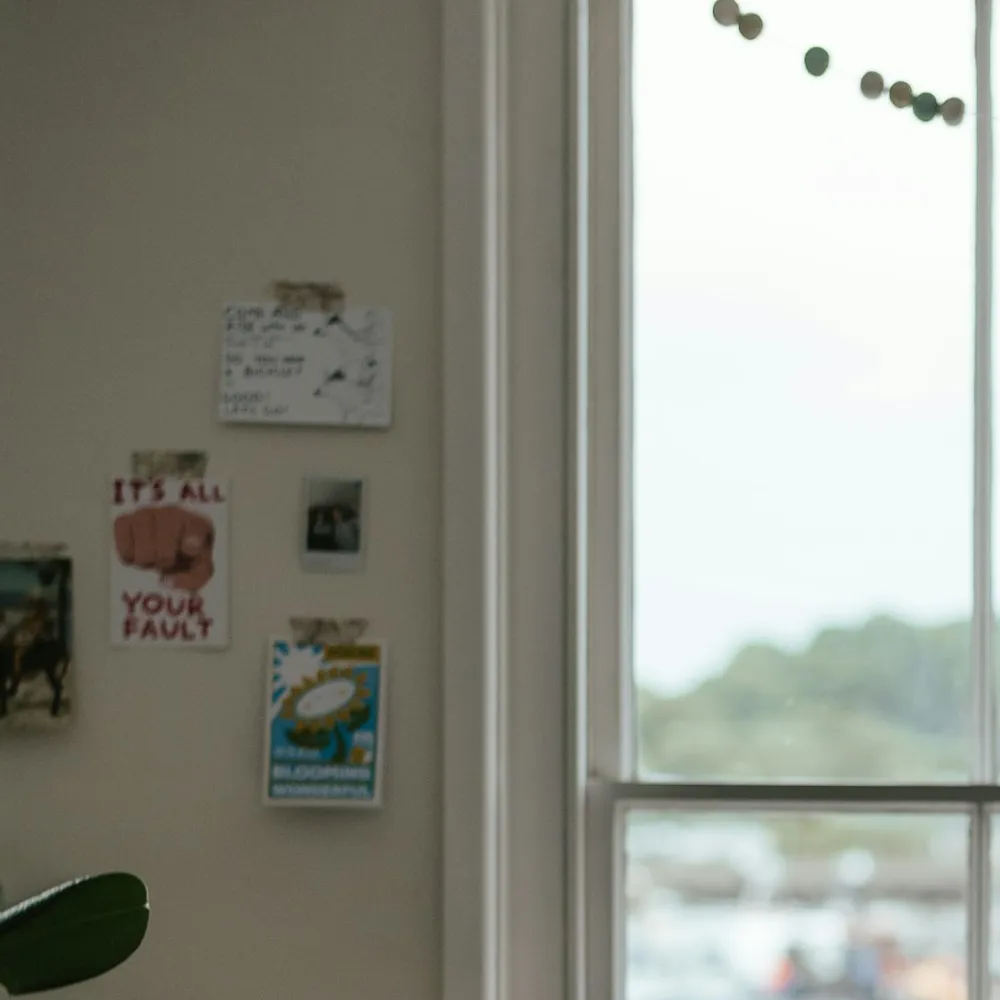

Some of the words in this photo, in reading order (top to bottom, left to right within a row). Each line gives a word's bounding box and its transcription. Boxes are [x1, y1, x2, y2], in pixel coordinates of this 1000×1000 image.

[113, 476, 166, 504] IT'S
[180, 481, 226, 503] ALL
[122, 591, 205, 618] YOUR
[123, 616, 213, 641] FAULT
